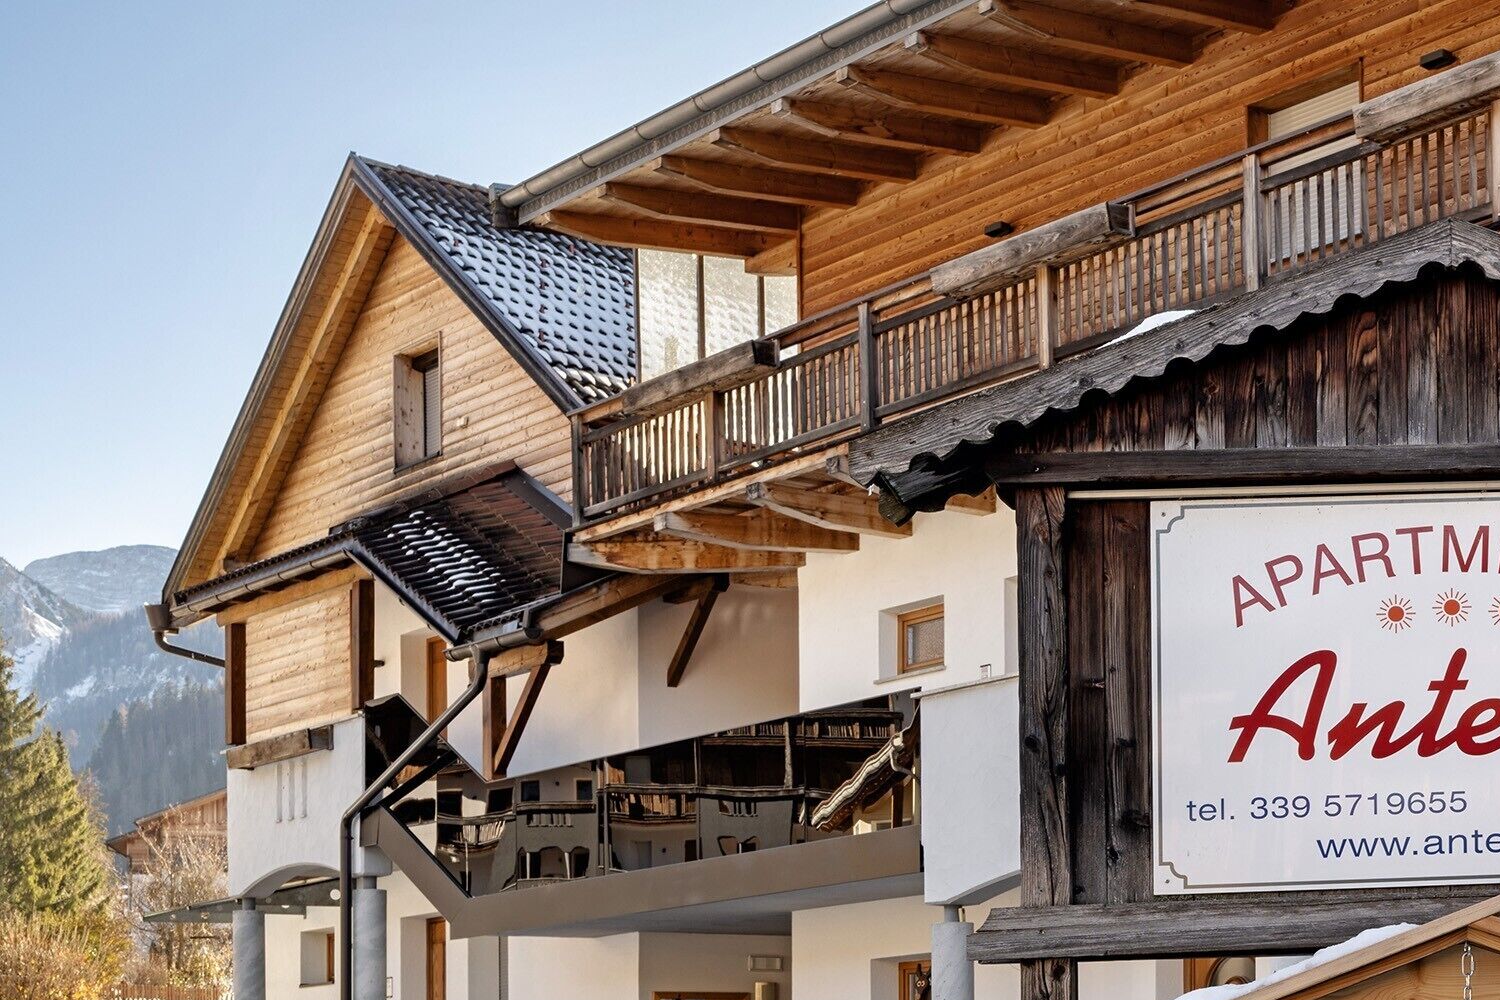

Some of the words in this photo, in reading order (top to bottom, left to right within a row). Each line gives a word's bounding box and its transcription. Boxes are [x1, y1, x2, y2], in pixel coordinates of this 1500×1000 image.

[1186, 798, 1235, 822] tel.
[1250, 794, 1311, 820] 339
[1324, 791, 1468, 817] 5719655
